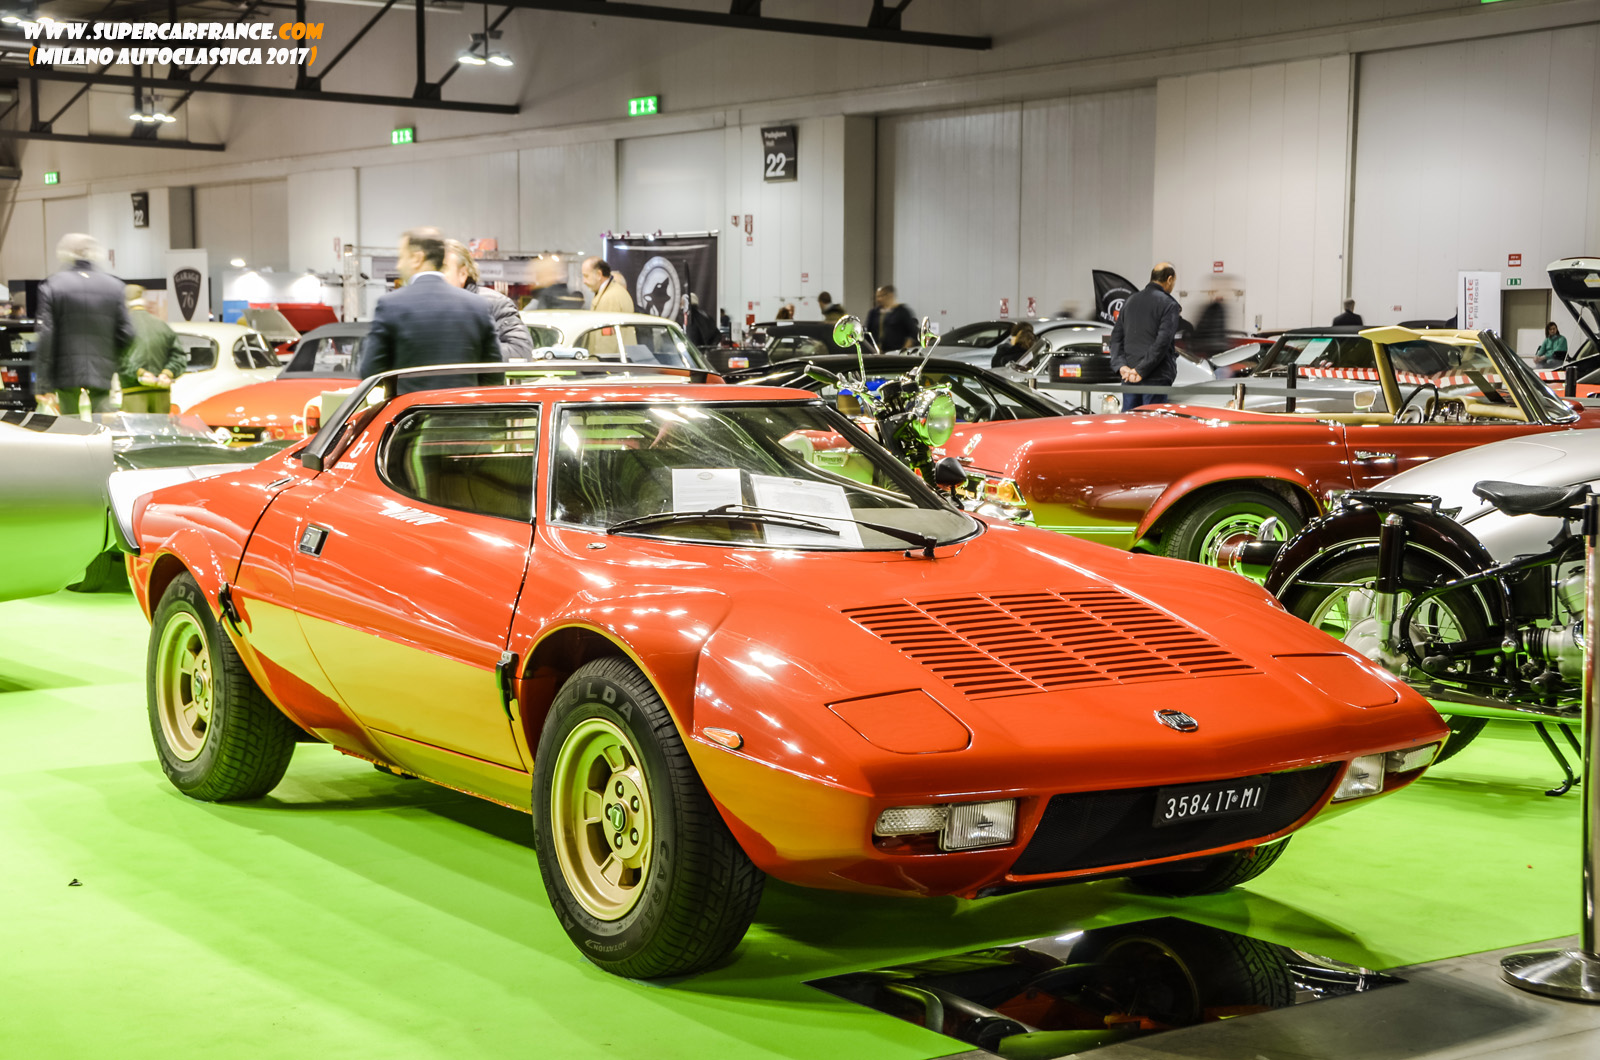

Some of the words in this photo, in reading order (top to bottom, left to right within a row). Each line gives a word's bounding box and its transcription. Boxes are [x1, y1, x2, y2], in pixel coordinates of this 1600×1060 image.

[766, 152, 787, 177] 22
[134, 209, 144, 226] 22
[181, 291, 195, 308] 76
[555, 682, 633, 723] FULDA
[639, 840, 669, 938] CARAT
